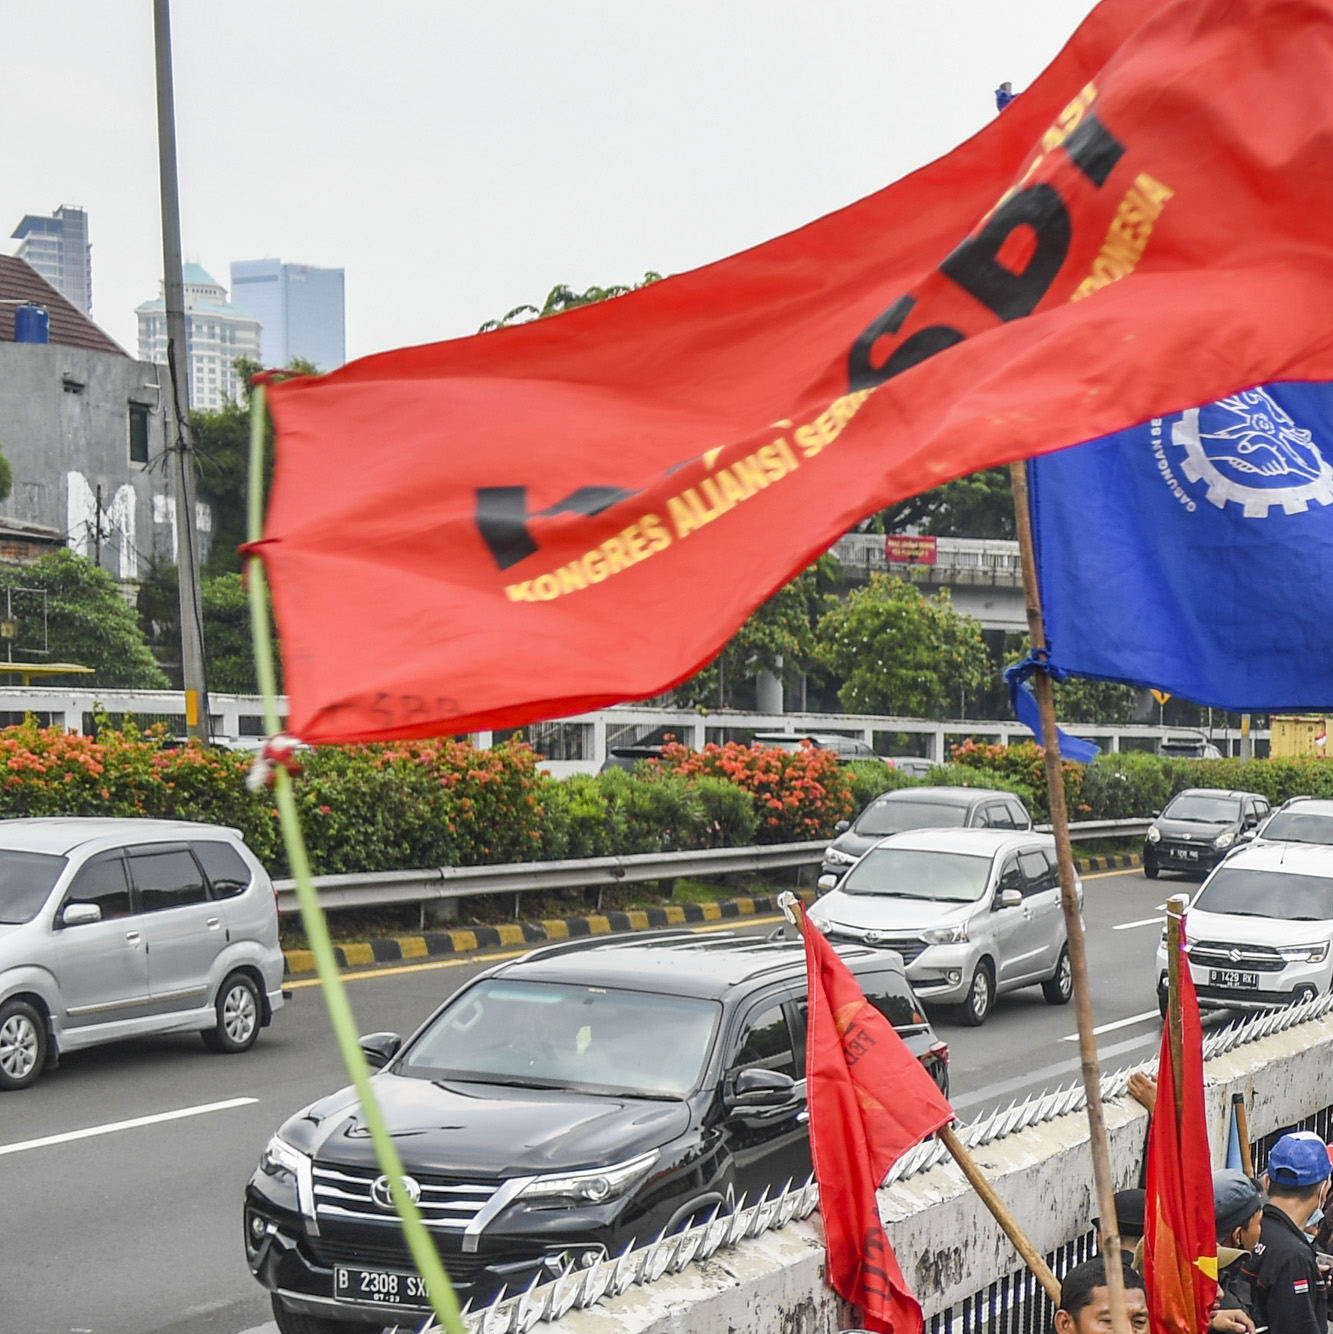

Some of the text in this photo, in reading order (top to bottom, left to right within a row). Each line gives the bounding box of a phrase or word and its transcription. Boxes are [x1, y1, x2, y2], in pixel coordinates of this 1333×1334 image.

[504, 512, 672, 601] KONGRES
[668, 437, 799, 538] ALIANSI
[1211, 971, 1217, 980] B
[1221, 972, 1240, 983] 1429
[338, 1269, 430, 1298] B 2308 SX
